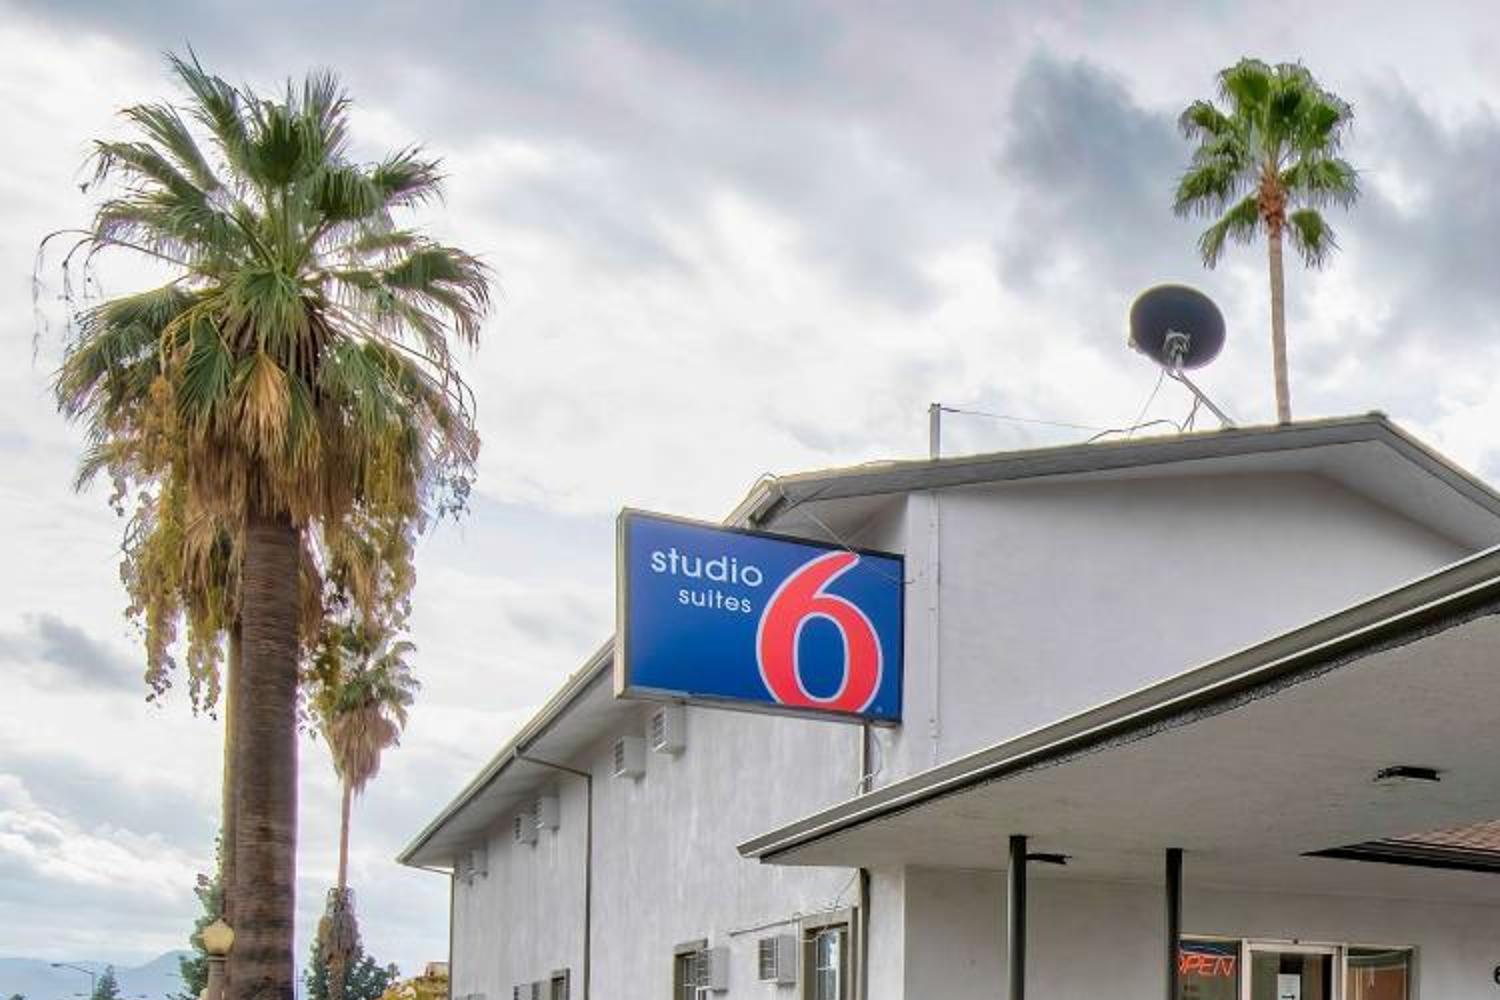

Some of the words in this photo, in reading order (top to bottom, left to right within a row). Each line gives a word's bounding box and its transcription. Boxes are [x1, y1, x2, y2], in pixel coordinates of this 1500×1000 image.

[651, 548, 763, 587] studio
[678, 588, 752, 613] suites
[755, 550, 884, 713] 6
